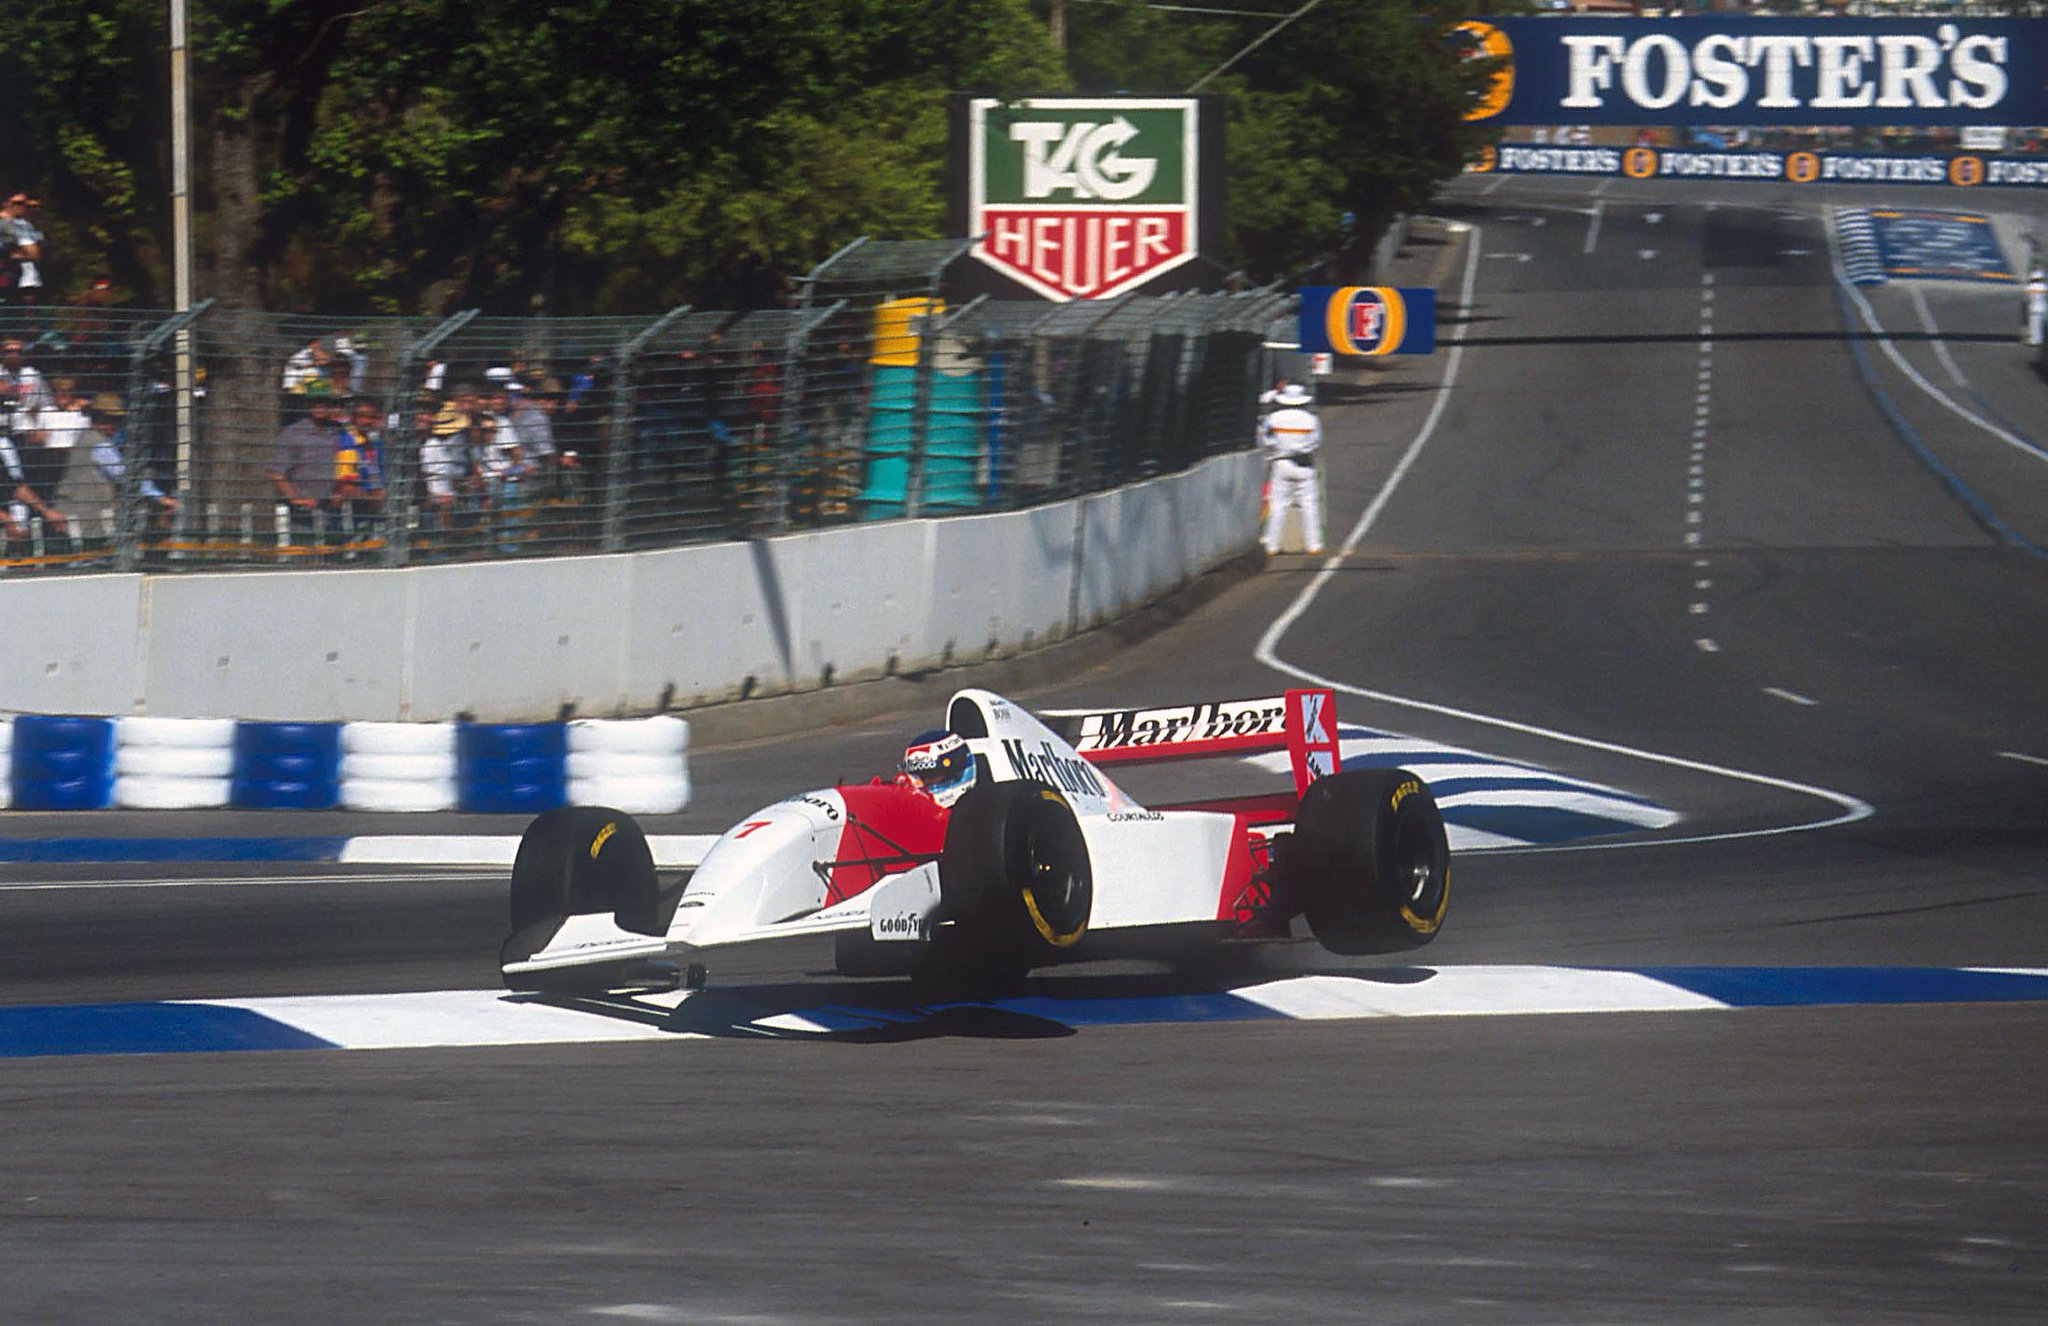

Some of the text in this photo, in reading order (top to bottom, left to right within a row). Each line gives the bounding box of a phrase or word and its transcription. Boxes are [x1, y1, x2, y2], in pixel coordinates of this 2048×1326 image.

[1560, 24, 2008, 109] FOSTER'S
[1010, 116, 1158, 200] TAG
[995, 217, 1170, 293] HEUER
[1091, 701, 1287, 749] Marlbor
[1001, 739, 1106, 797] Marlboro
[734, 821, 772, 839] 7
